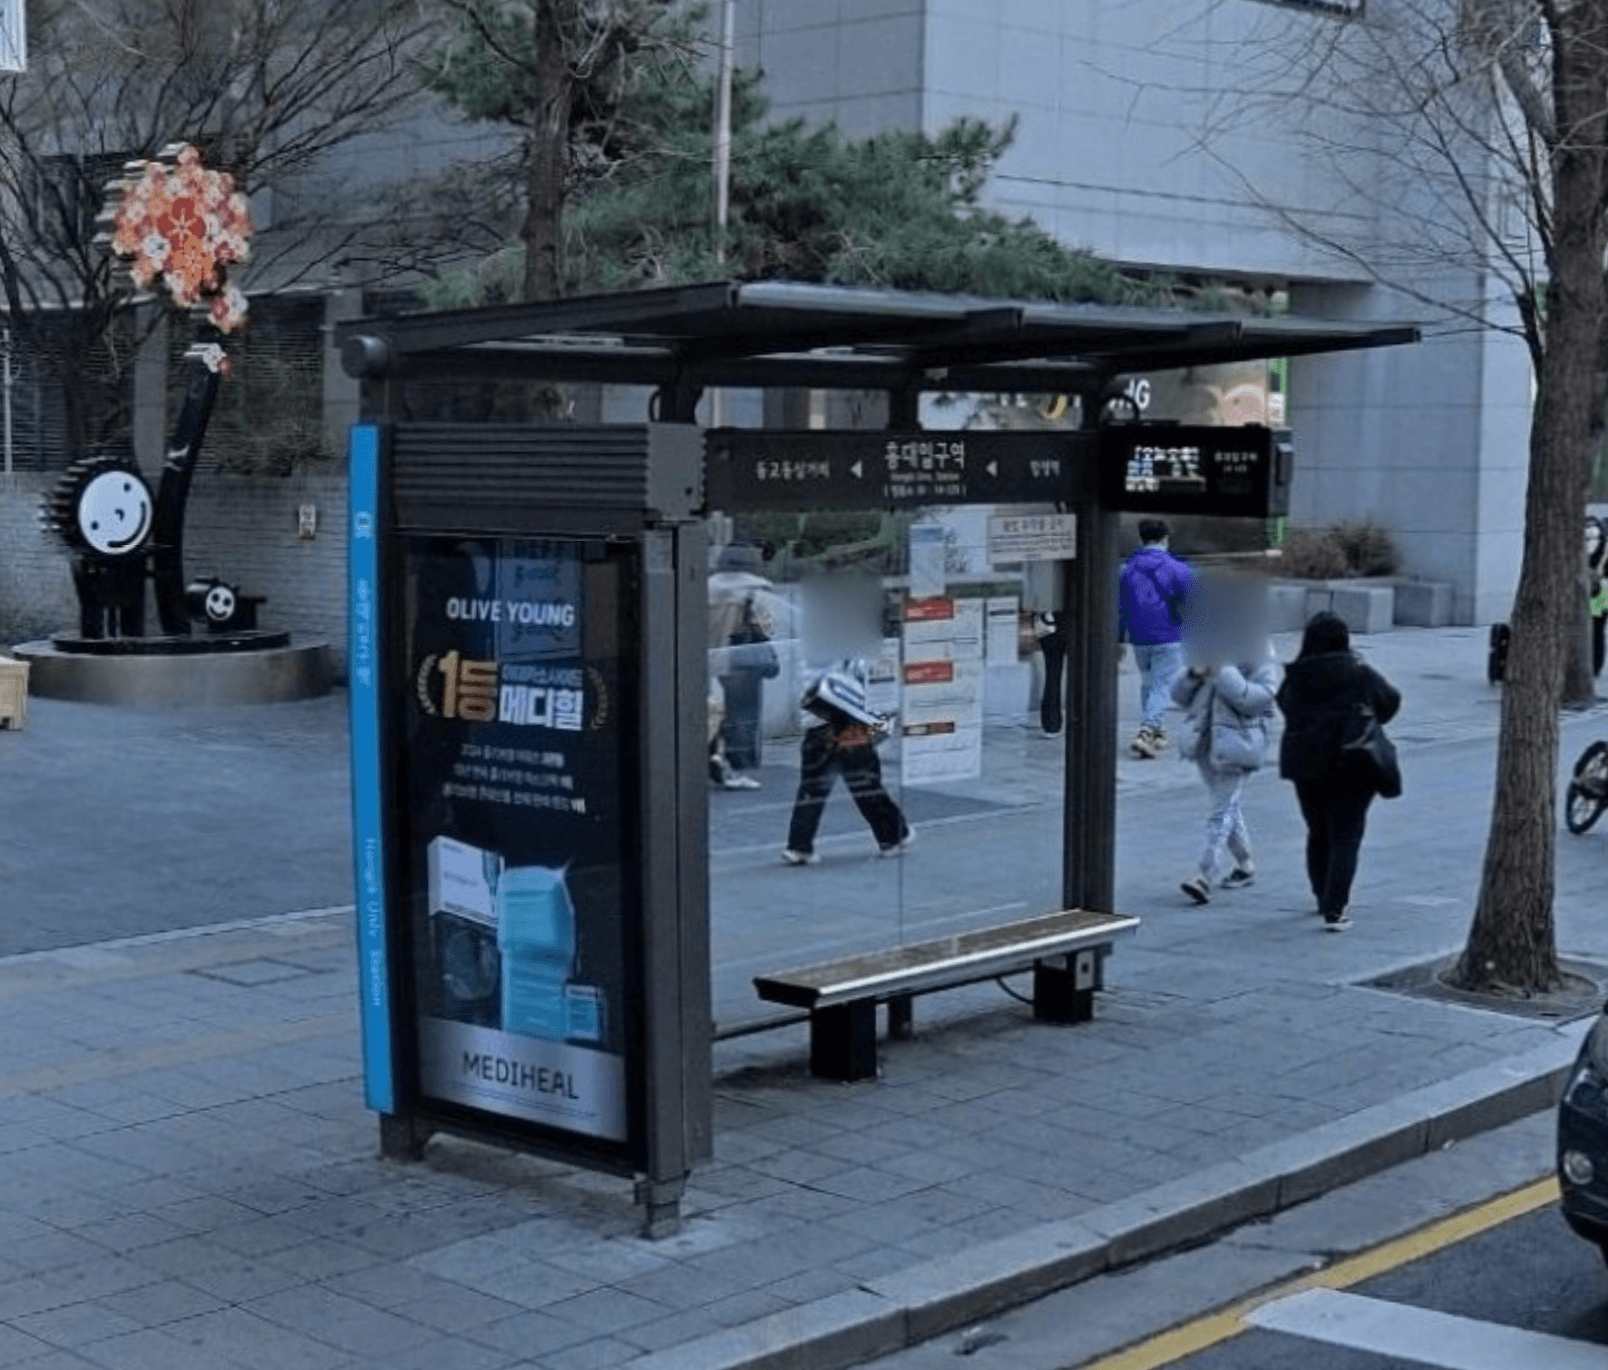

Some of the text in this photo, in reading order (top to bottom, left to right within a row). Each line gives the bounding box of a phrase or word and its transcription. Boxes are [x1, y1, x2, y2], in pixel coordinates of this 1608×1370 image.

[885, 440, 965, 470] 홍대입구역
[446, 597, 576, 627] OLIVE YOUNG
[499, 685, 584, 731] 메디힐
[462, 1051, 581, 1100] MEDIHEAL
